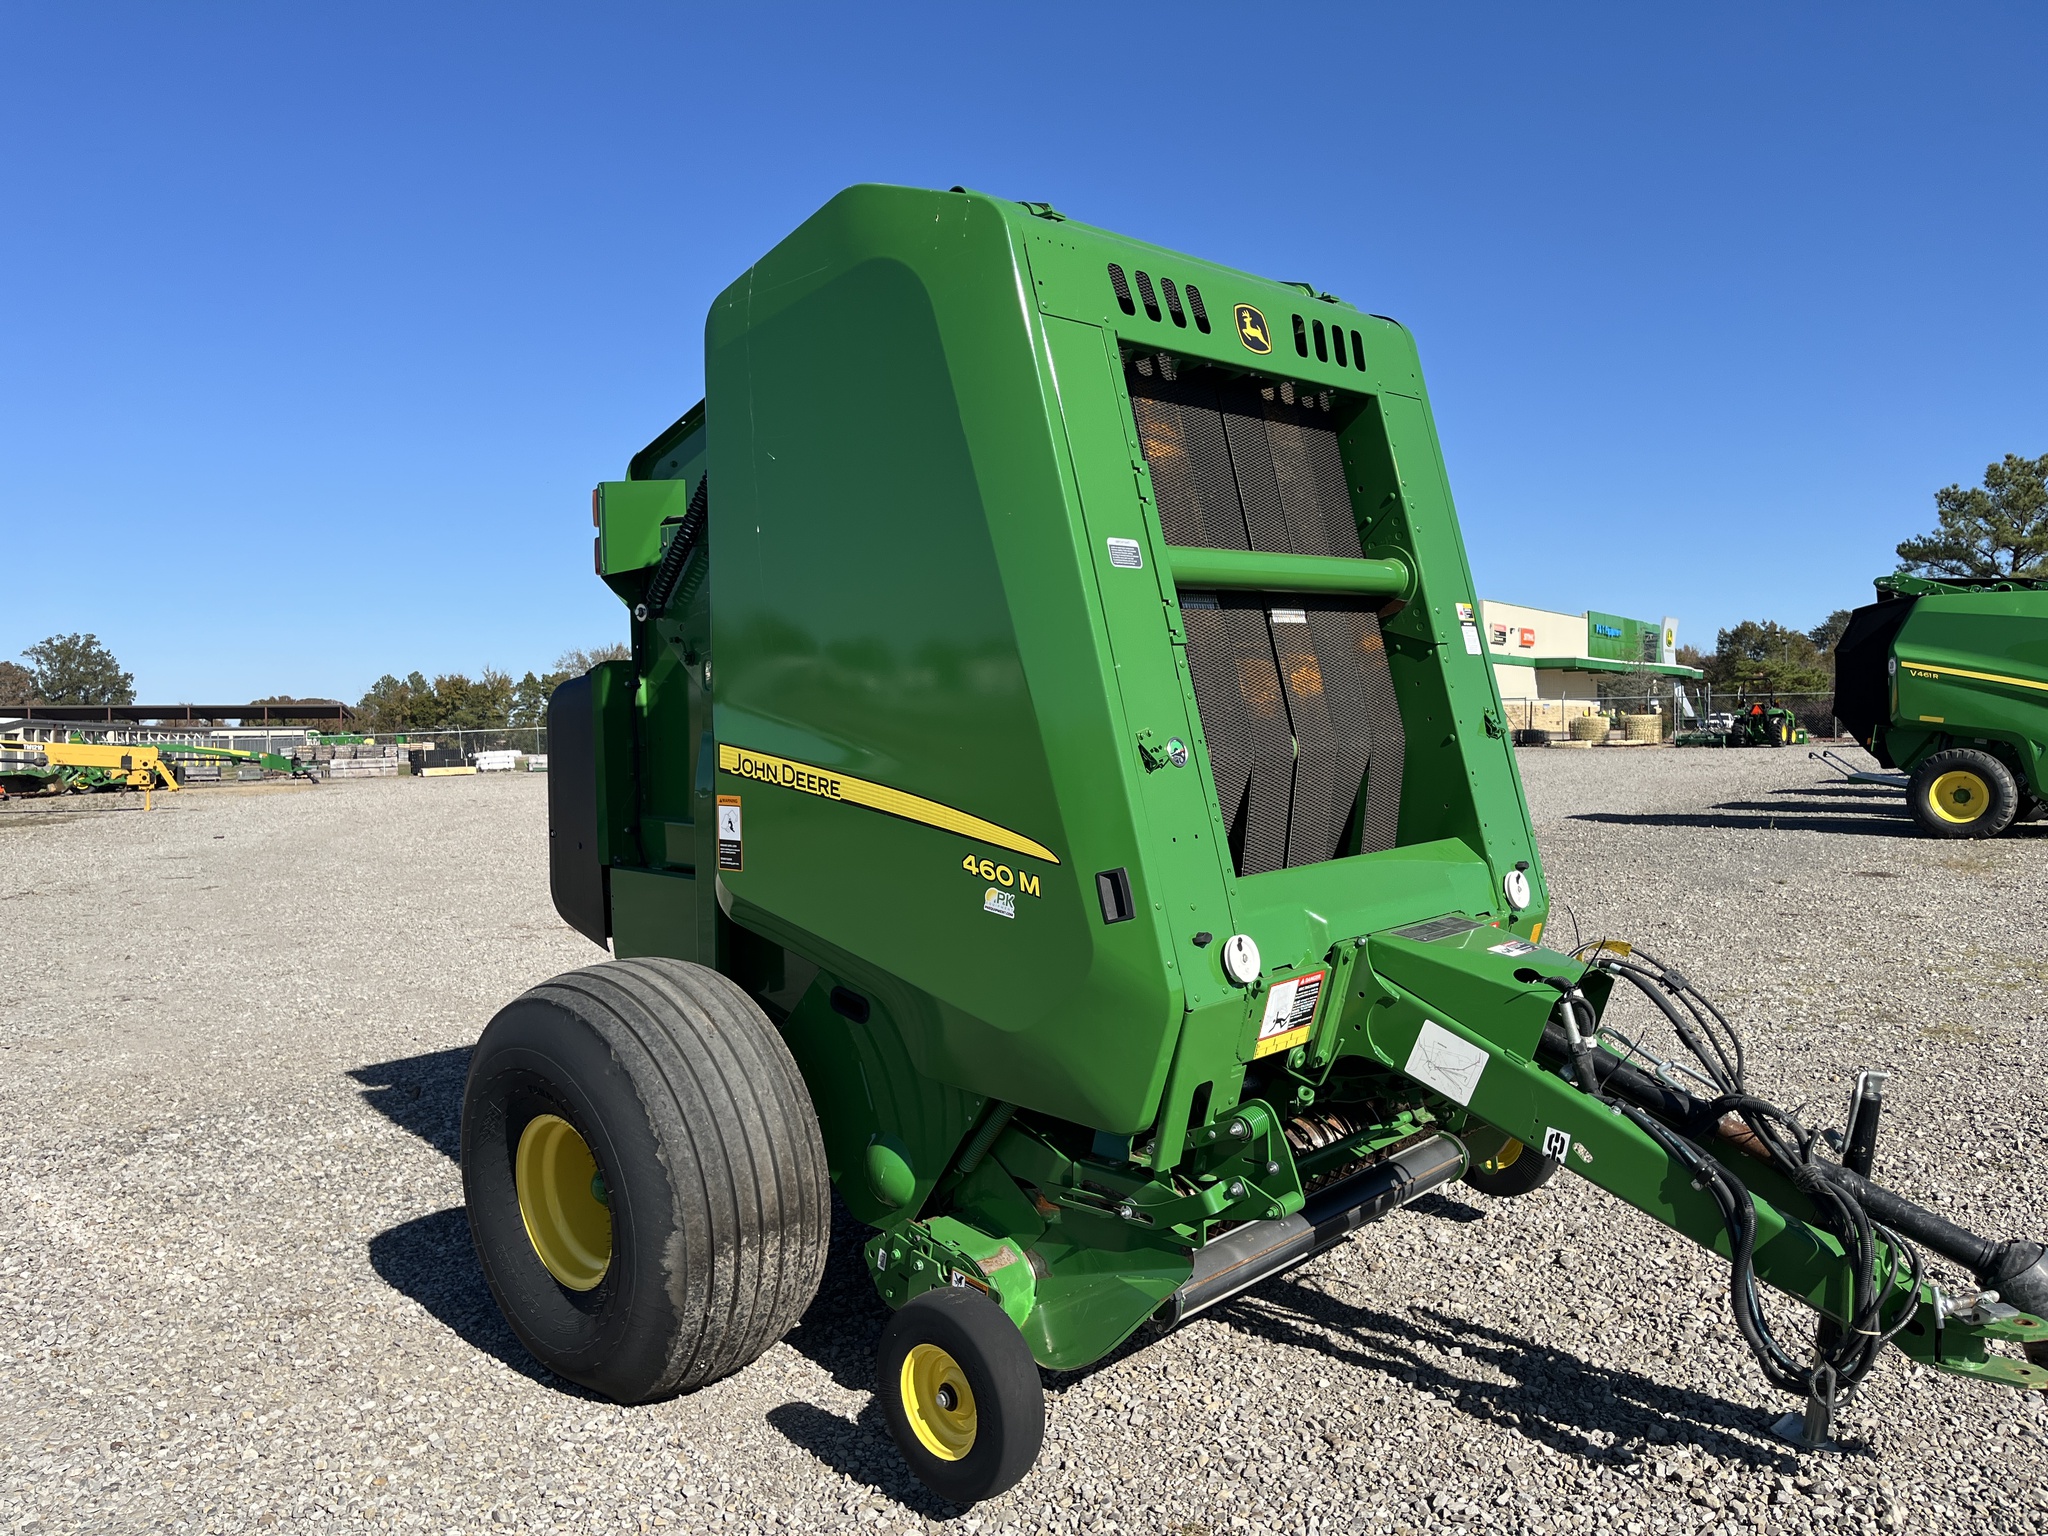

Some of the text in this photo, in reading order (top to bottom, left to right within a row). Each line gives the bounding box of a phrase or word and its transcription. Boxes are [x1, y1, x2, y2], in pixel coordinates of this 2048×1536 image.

[732, 753, 841, 798] JOHN DEERE
[962, 853, 1041, 898] 460 M
